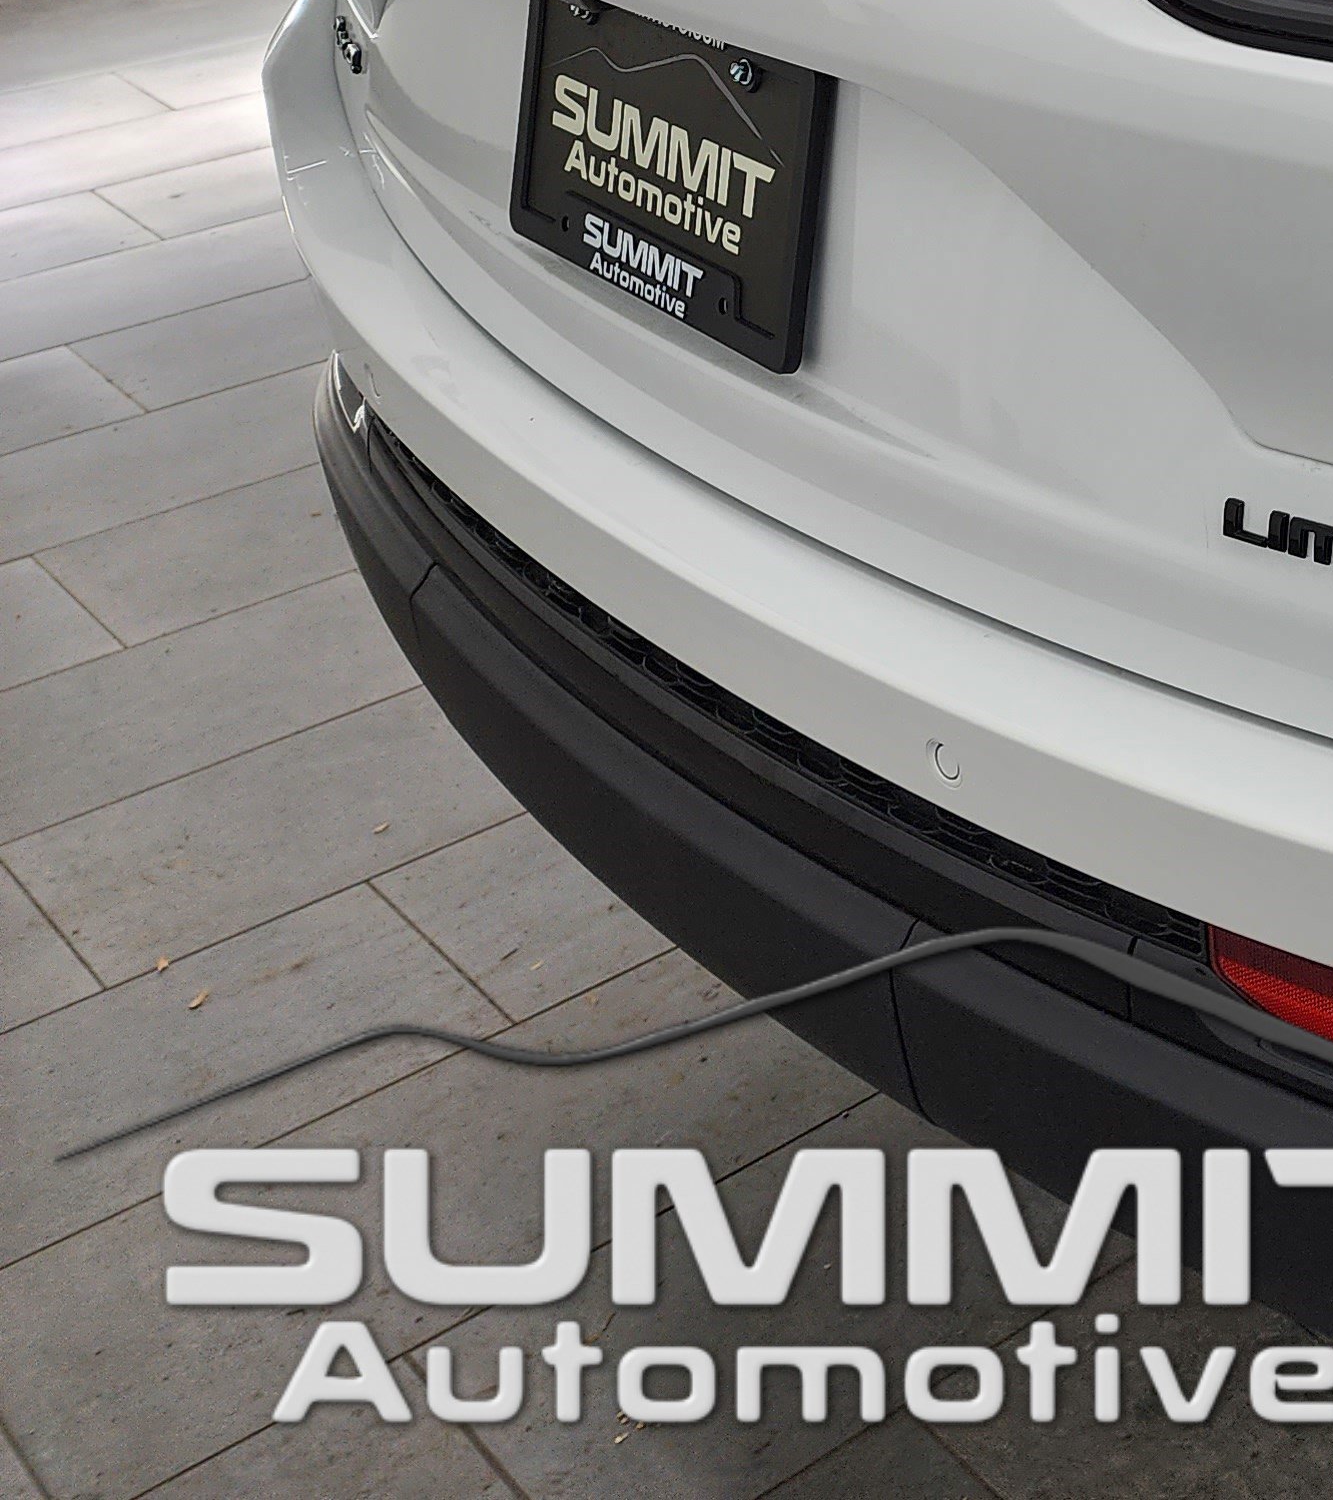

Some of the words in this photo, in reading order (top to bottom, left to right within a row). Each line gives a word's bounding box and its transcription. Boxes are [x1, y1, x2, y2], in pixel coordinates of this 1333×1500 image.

[551, 73, 776, 219] SUMMIT
[563, 139, 742, 256] Automotive
[582, 213, 704, 298] SUMMIT
[588, 252, 686, 319] Automotive
